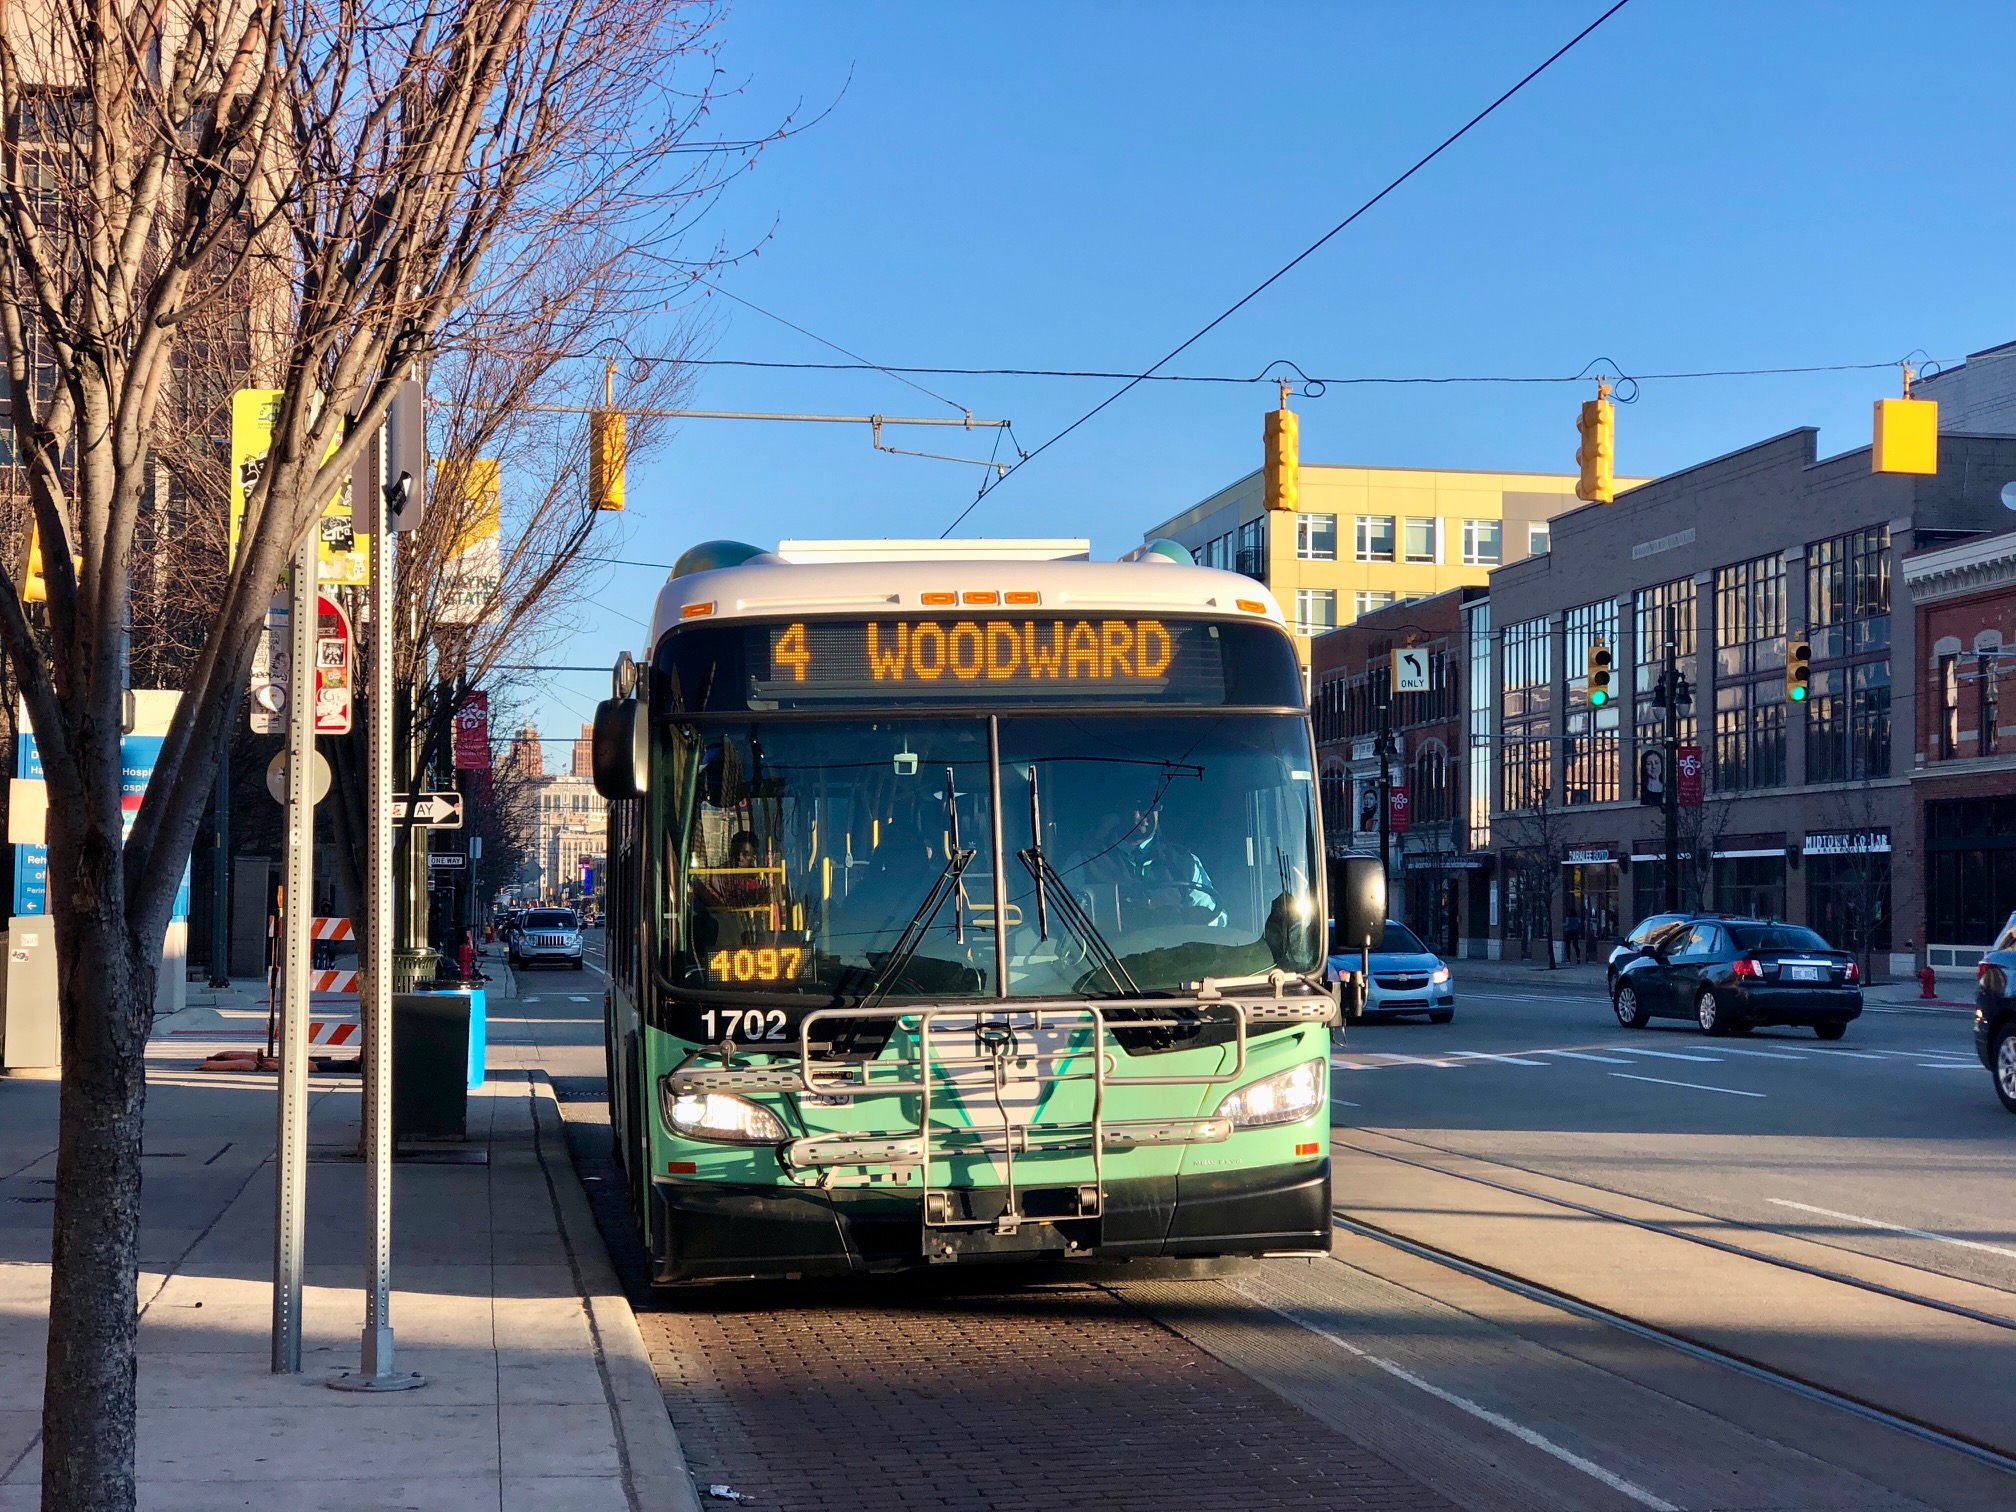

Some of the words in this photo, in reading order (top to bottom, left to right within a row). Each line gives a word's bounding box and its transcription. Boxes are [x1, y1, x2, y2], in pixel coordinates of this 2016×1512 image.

[774, 622, 812, 682] 4
[866, 620, 1172, 681] WOODWARD
[1401, 679, 1425, 688] ONLY
[122, 767, 154, 779] Hospi
[416, 803, 433, 816] AY
[1805, 834, 1850, 849] MIDTOWN
[709, 946, 802, 983] 4097
[701, 1009, 787, 1040] 1702
